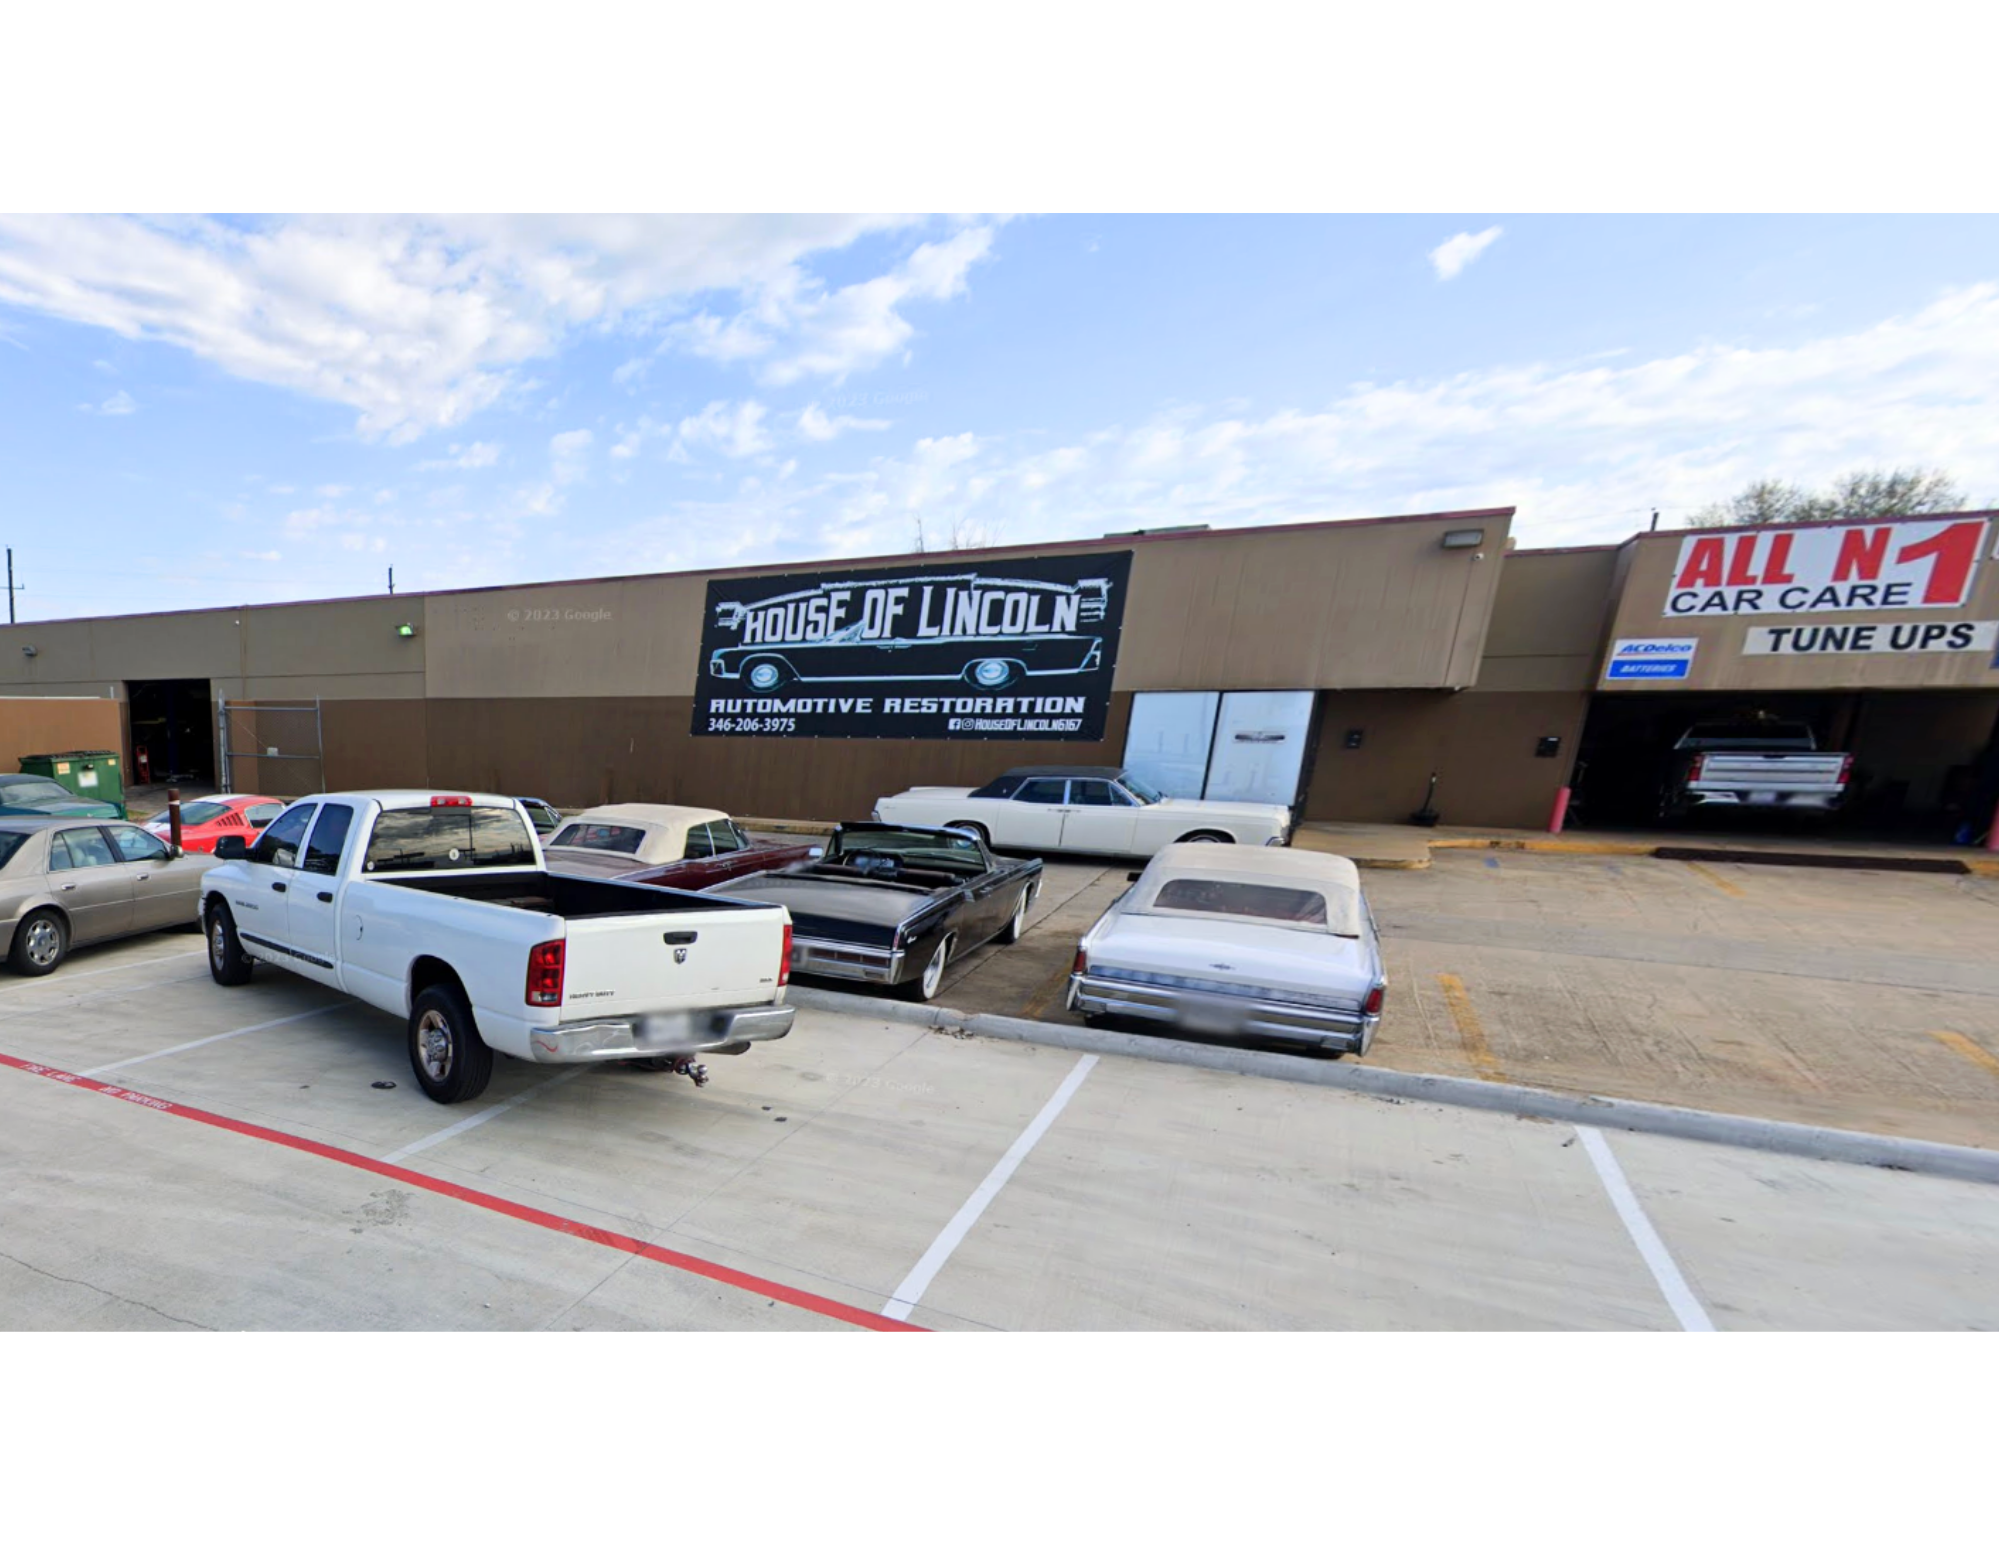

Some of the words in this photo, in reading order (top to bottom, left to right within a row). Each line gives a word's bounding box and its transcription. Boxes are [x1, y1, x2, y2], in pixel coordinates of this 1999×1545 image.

[1676, 532, 1796, 589] ALL
[1830, 527, 1893, 583] N
[1895, 520, 1986, 605] 1
[1670, 588, 1764, 613] CAR
[1778, 582, 1912, 610] CARE
[743, 591, 851, 644] HOUSE
[861, 587, 909, 640] OF
[916, 586, 1081, 638] LINCOLN
[1621, 643, 1693, 654] ACDelco
[1768, 626, 1877, 652] TUNE
[1889, 623, 1976, 650] UPS
[1620, 664, 1678, 674] BATTERIES
[709, 698, 874, 714] AUTOMOTIVE
[883, 696, 1087, 714] RESTORATION
[708, 718, 796, 732] 346-206-3975
